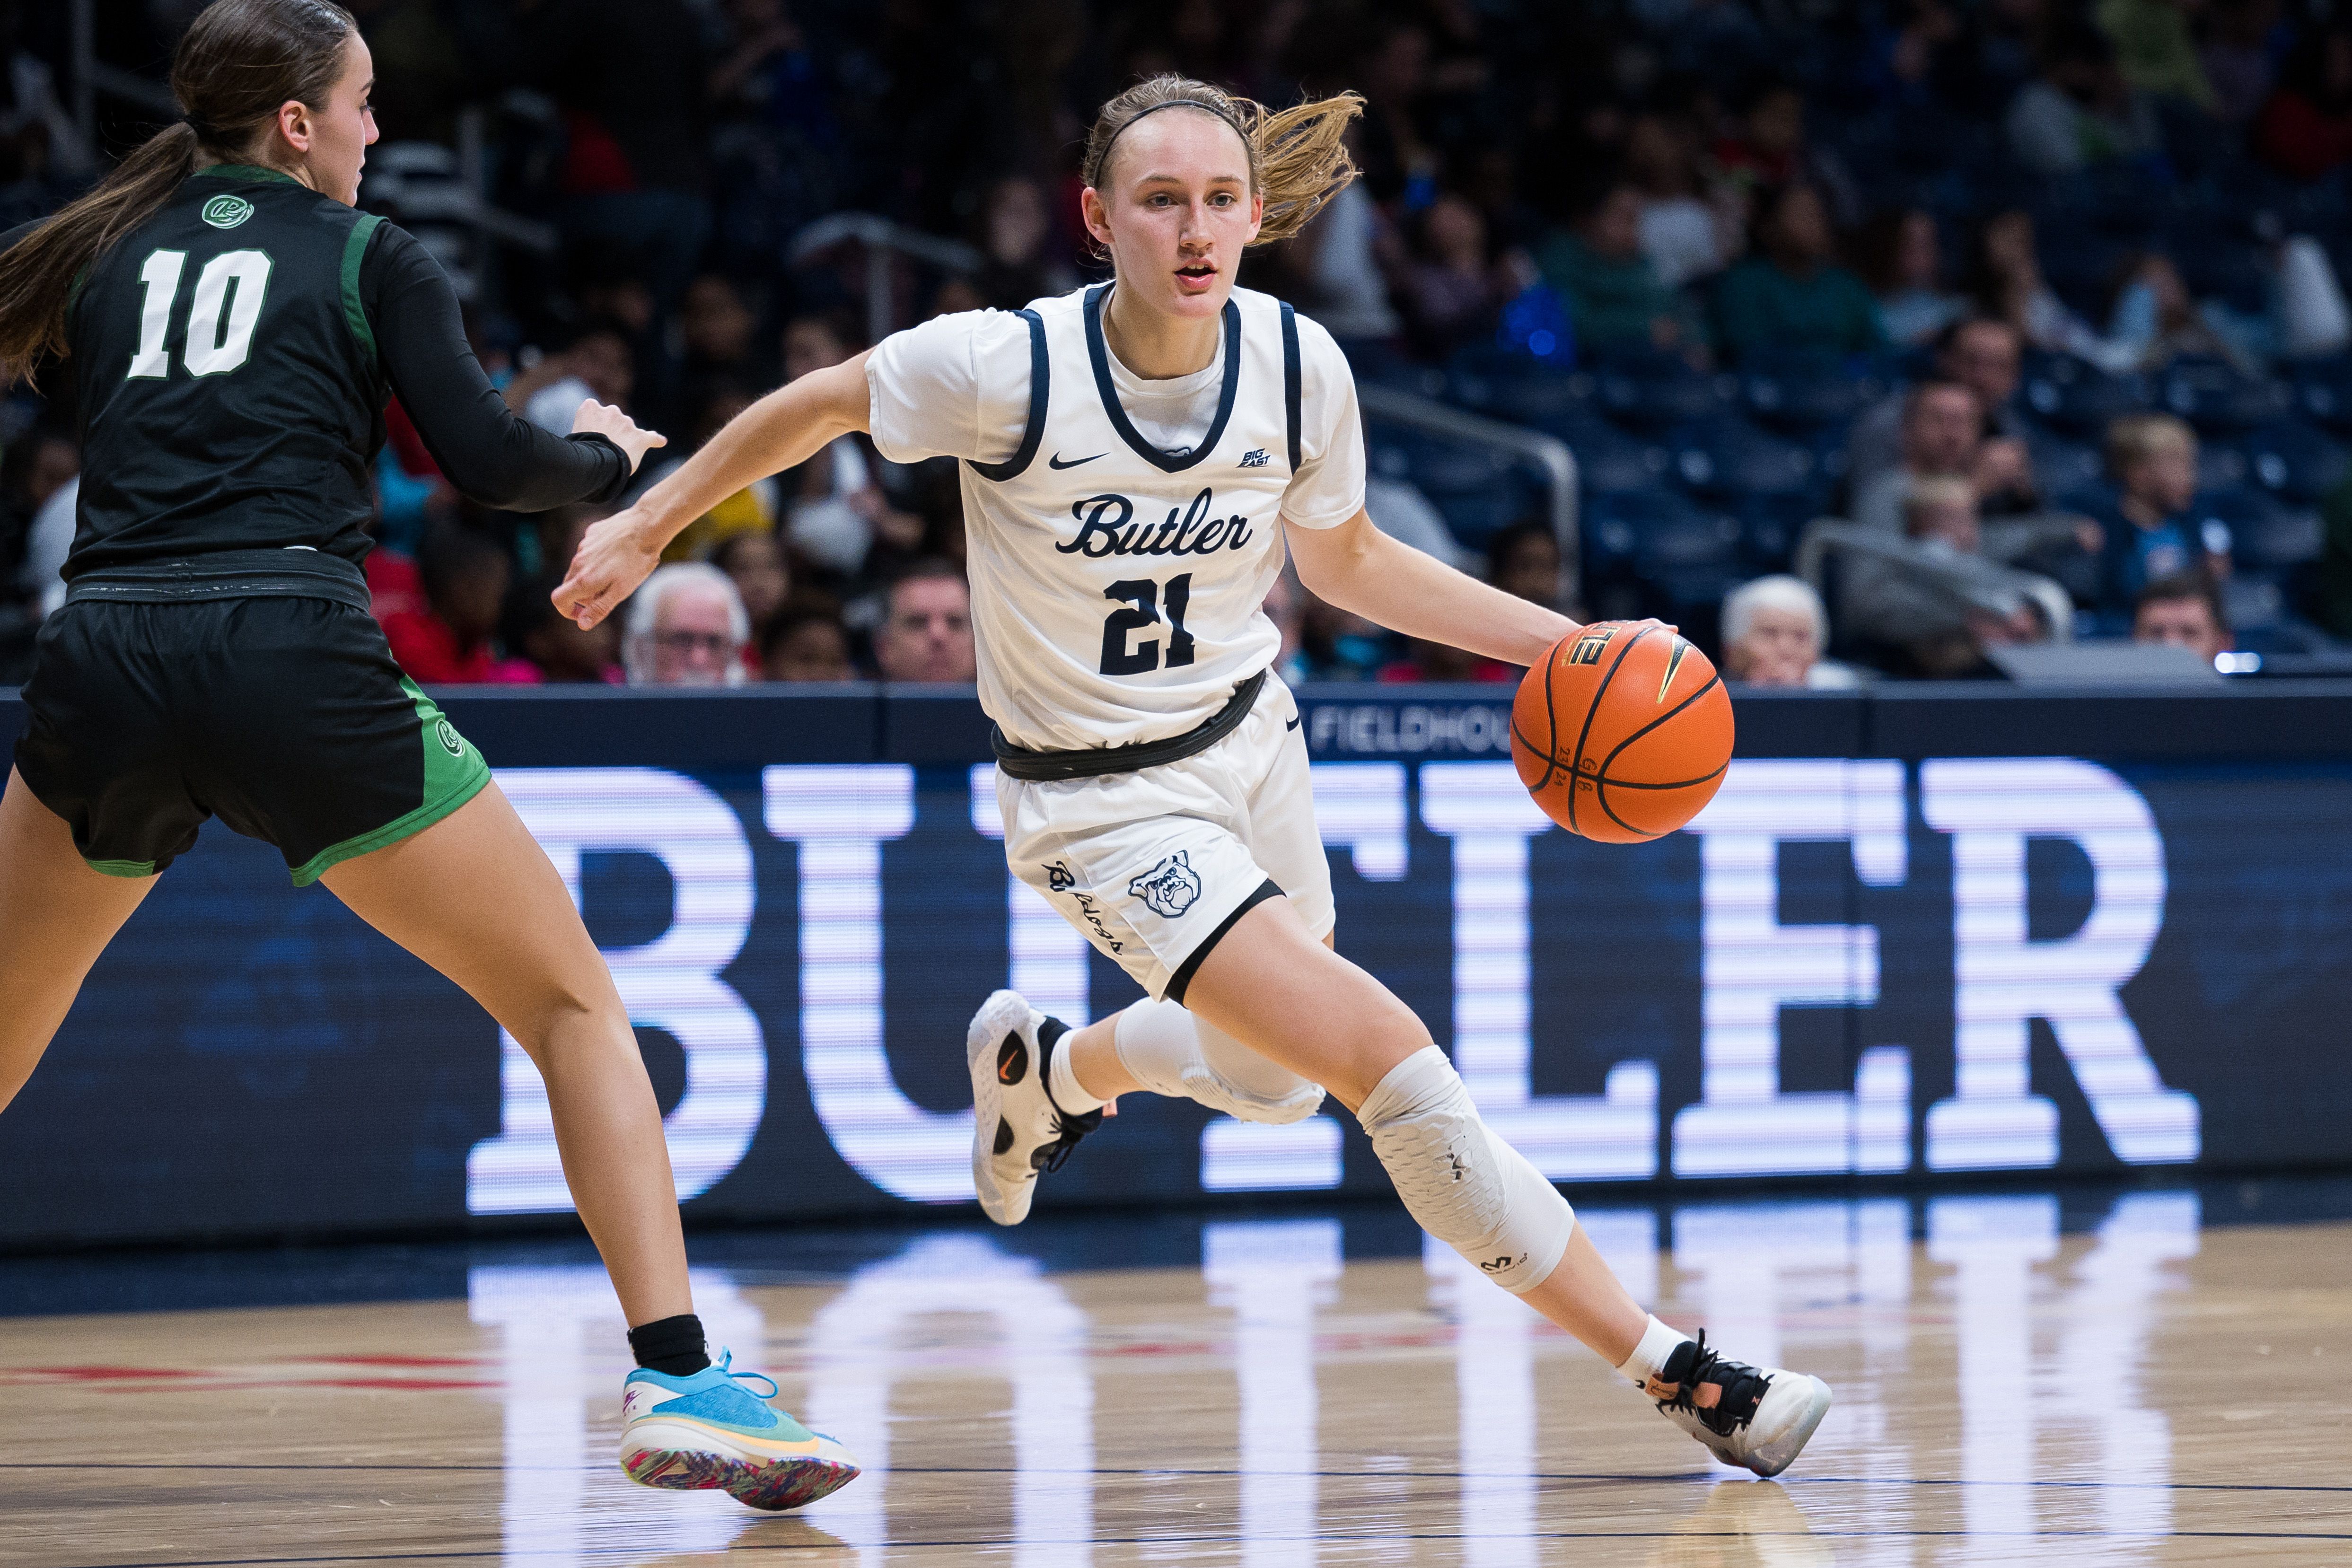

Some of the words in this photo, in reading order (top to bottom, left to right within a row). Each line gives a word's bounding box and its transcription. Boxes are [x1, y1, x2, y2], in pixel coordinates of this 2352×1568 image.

[125, 247, 275, 380] 10
[1235, 455, 1271, 468] EAST
[1242, 447, 1266, 462] BIG
[1055, 487, 1253, 558] Butler
[1099, 572, 1196, 676] 21
[1310, 705, 1510, 753] FIELDHOU
[1041, 860, 1123, 956] Buldogs
[465, 756, 2201, 1215] BULER
